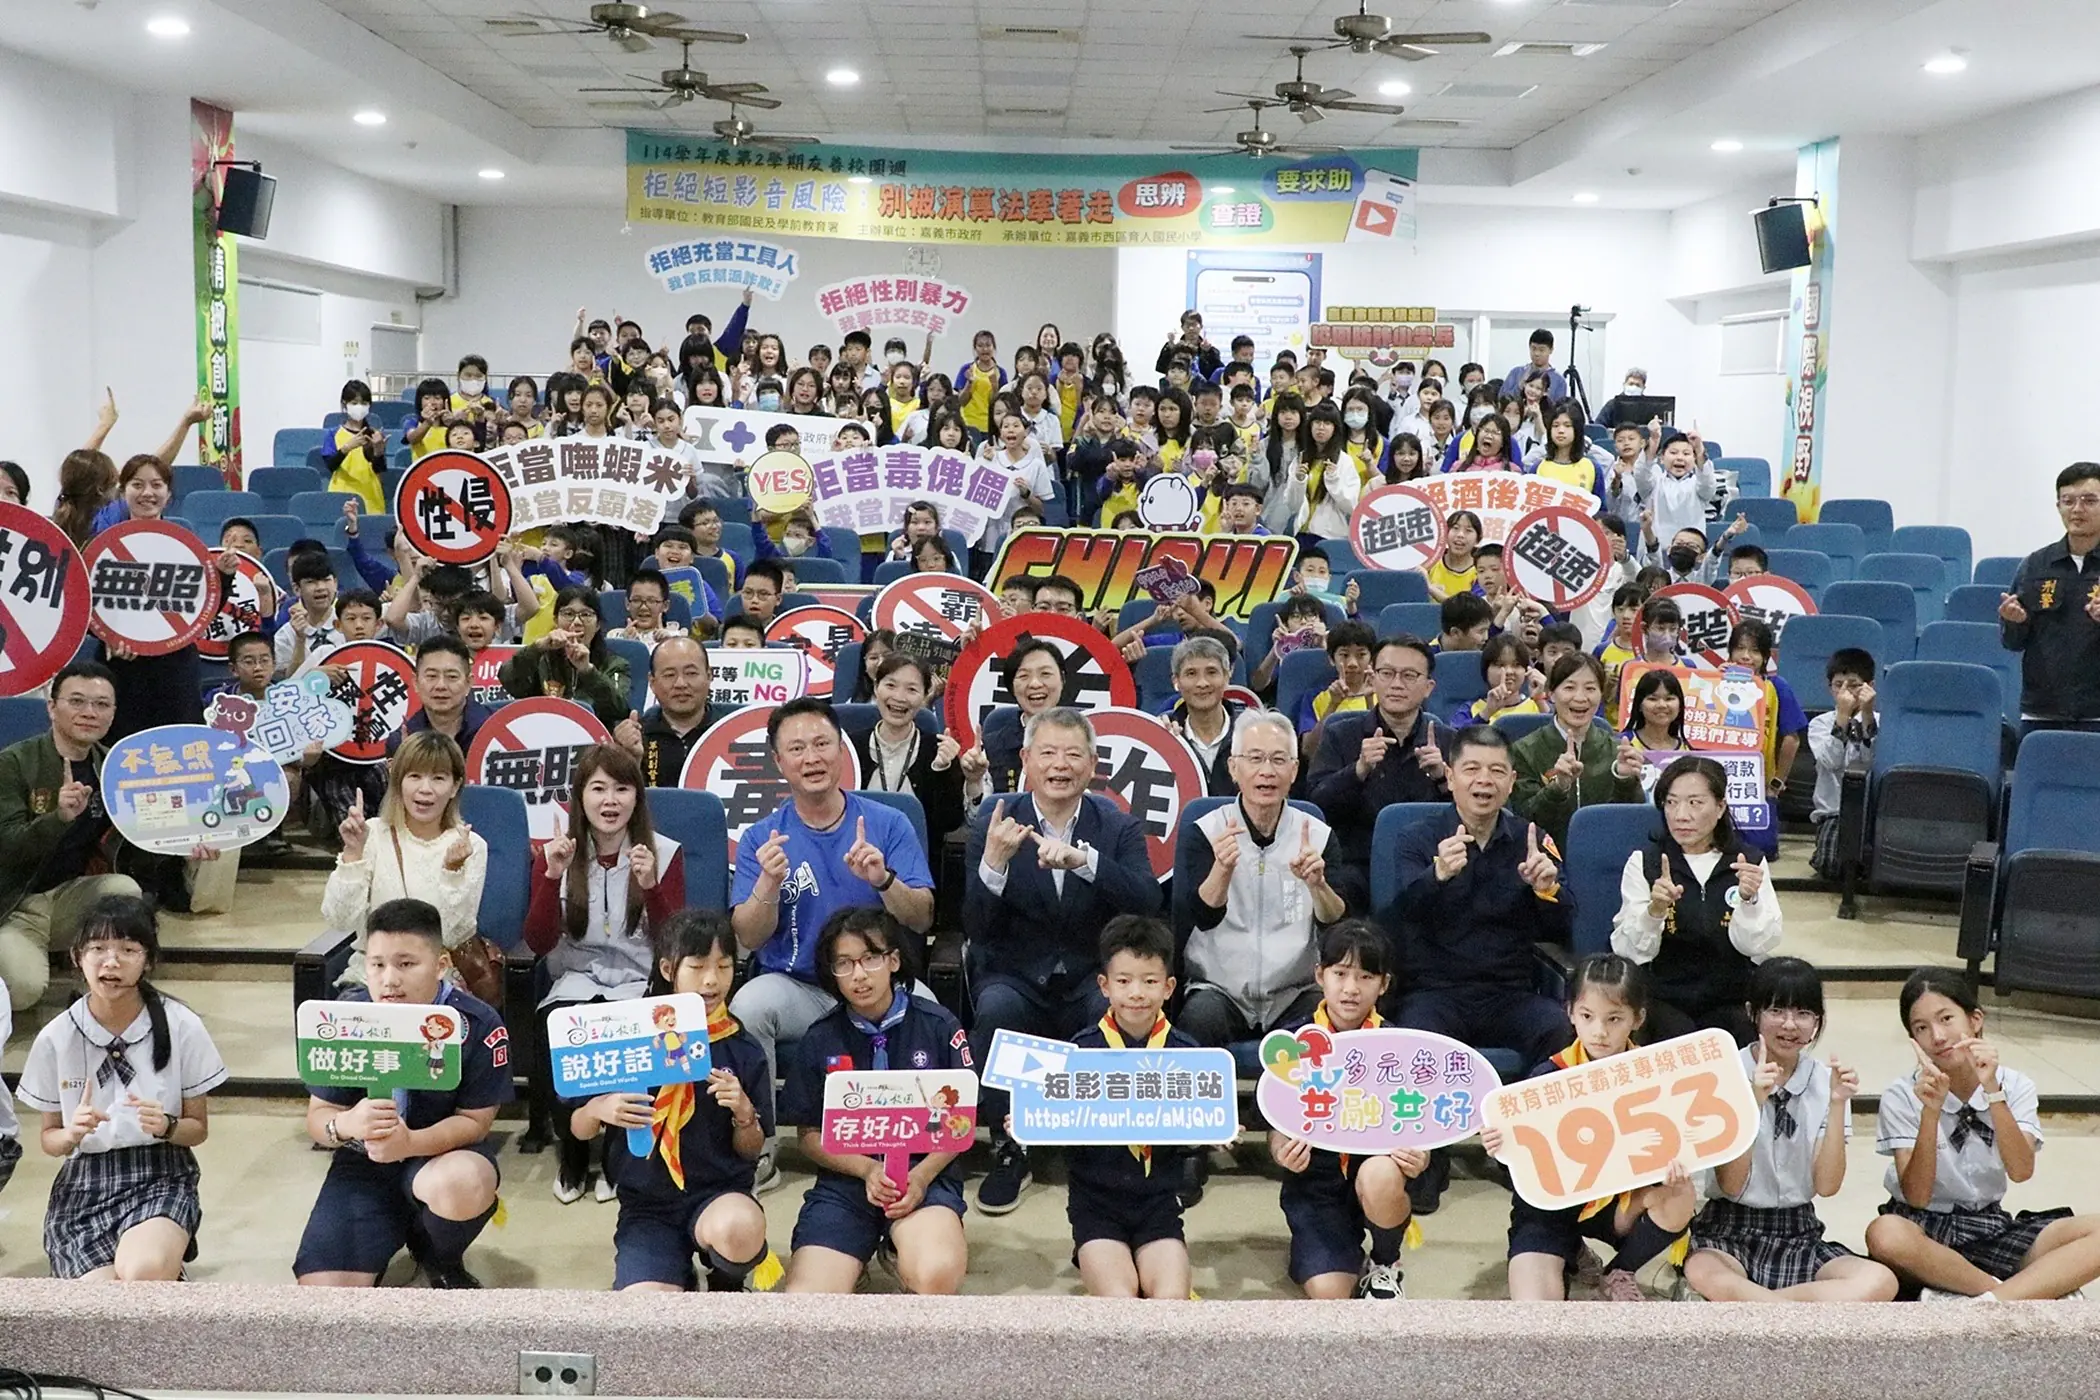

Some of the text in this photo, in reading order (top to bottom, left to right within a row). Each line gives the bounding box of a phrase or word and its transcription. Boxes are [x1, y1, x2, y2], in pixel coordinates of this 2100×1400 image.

[643, 145, 908, 177] 114學年度第2學期友善校園週
[1135, 182, 1186, 208] 思辨
[1276, 168, 1352, 194] 要求助
[878, 183, 1114, 225] 別被演算法牽著走
[1211, 203, 1264, 228] 查證
[640, 206, 840, 234] 指導單位：教育部國民及學前教育署
[857, 222, 983, 242] 主辦單位：嘉義市政府
[1001, 229, 1202, 244] 承辦單位：嘉義市西區育人國民小學
[650, 240, 798, 277] 拒絕充當工具人
[820, 279, 969, 317] 拒絕性別暴力
[418, 476, 497, 542] 性侵
[1361, 506, 1435, 556] 超速
[1514, 523, 1600, 593] 超速
[93, 558, 204, 614] 無照
[744, 661, 784, 681] ING
[268, 683, 300, 718] 安
[754, 683, 788, 702] NG
[1727, 782, 1759, 800] 行員
[307, 1046, 402, 1074] 做好事
[560, 1045, 653, 1082] 說好話
[1344, 1048, 1474, 1085] 多元參與
[618, 1076, 639, 1084] Words
[1044, 1071, 1224, 1100] 短影音識讀站
[1498, 1035, 1725, 1118] 教育部反霸凌專線電話
[1024, 1105, 1226, 1130] https://reurl.cc/aMjQvD
[1300, 1086, 1474, 1133] 共融共好
[832, 1115, 920, 1141] 存好心
[1513, 1071, 1739, 1197] 1953
